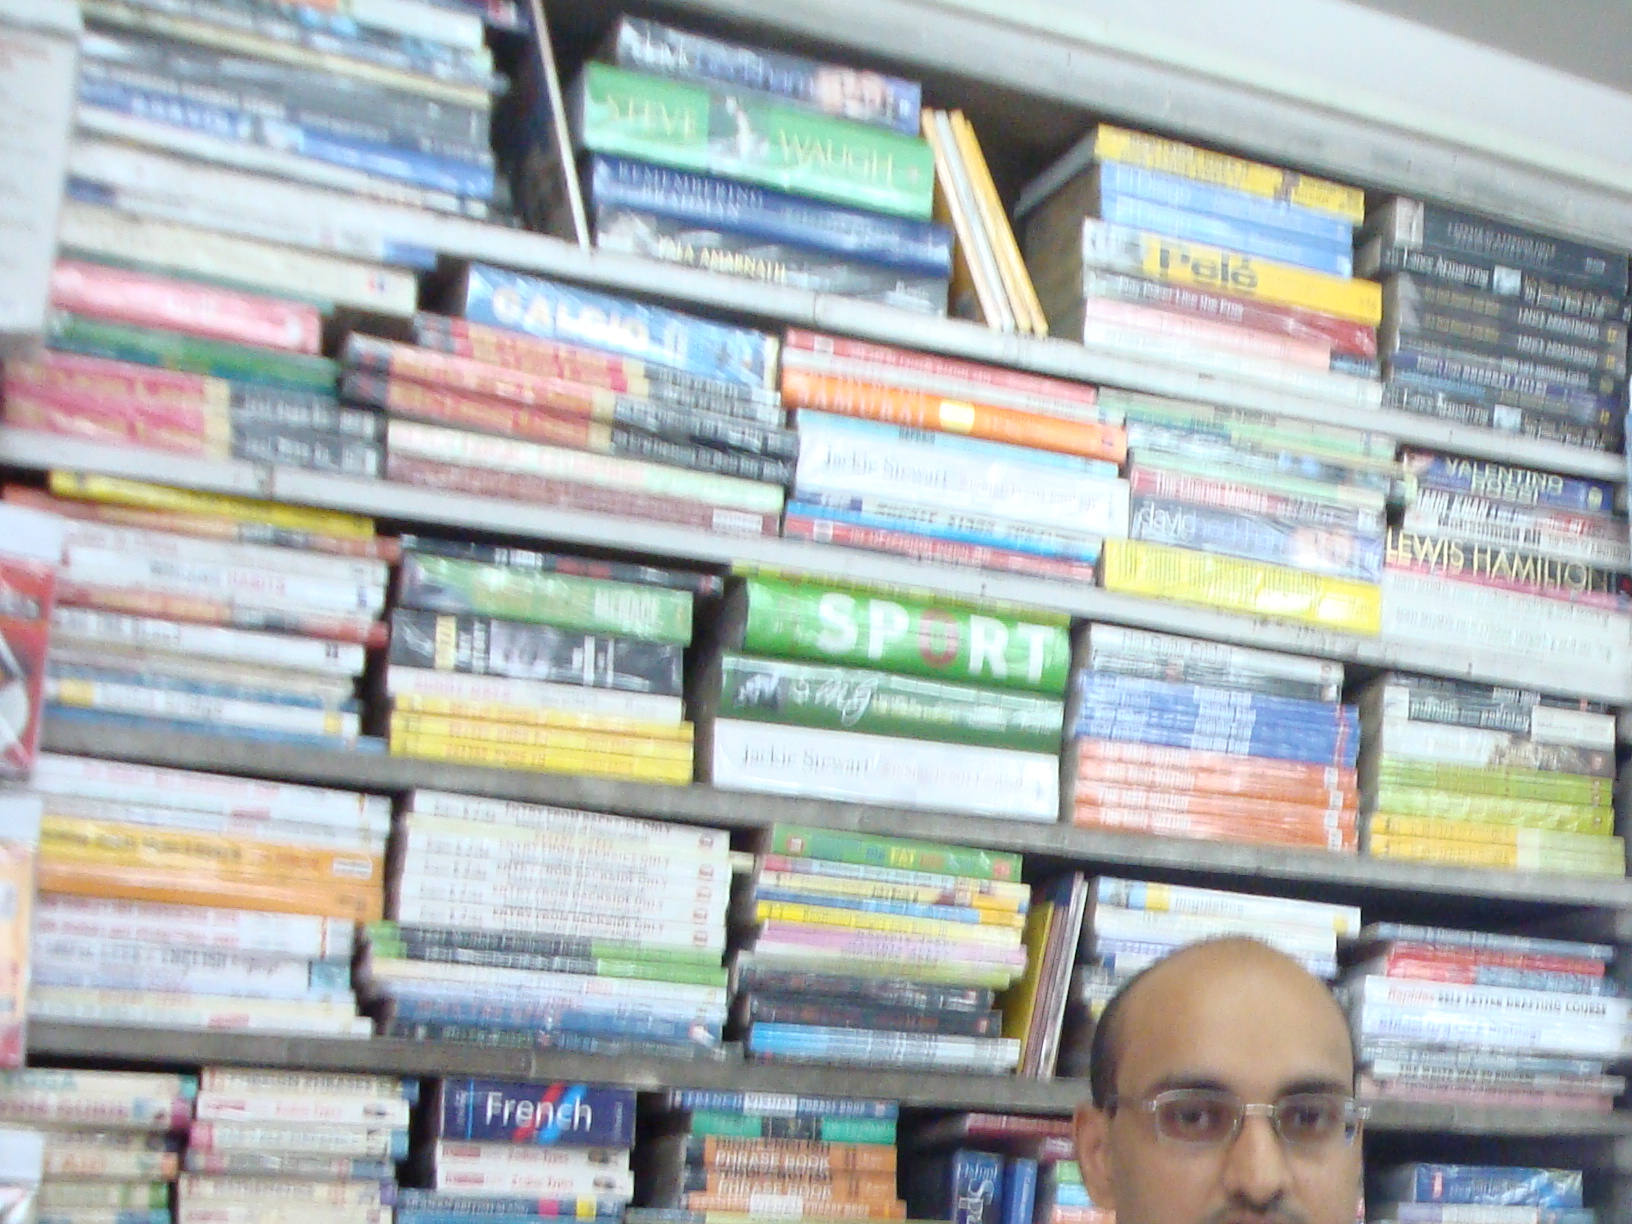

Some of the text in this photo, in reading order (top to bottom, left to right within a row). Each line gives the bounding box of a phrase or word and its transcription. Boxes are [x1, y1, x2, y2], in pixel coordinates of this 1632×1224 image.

[780, 128, 893, 186] WAUGH
[1446, 457, 1563, 496] VALENTINO
[1386, 527, 1608, 594] LEWIS HAMILTON
[817, 593, 1055, 684] SPORT
[742, 744, 872, 778] Jackie Stewart
[1565, 1000, 1607, 1016] COURSE
[486, 1090, 593, 1132] French
[715, 1151, 830, 1169] PHRASE BOOK
[718, 1180, 782, 1197] PHRASE
